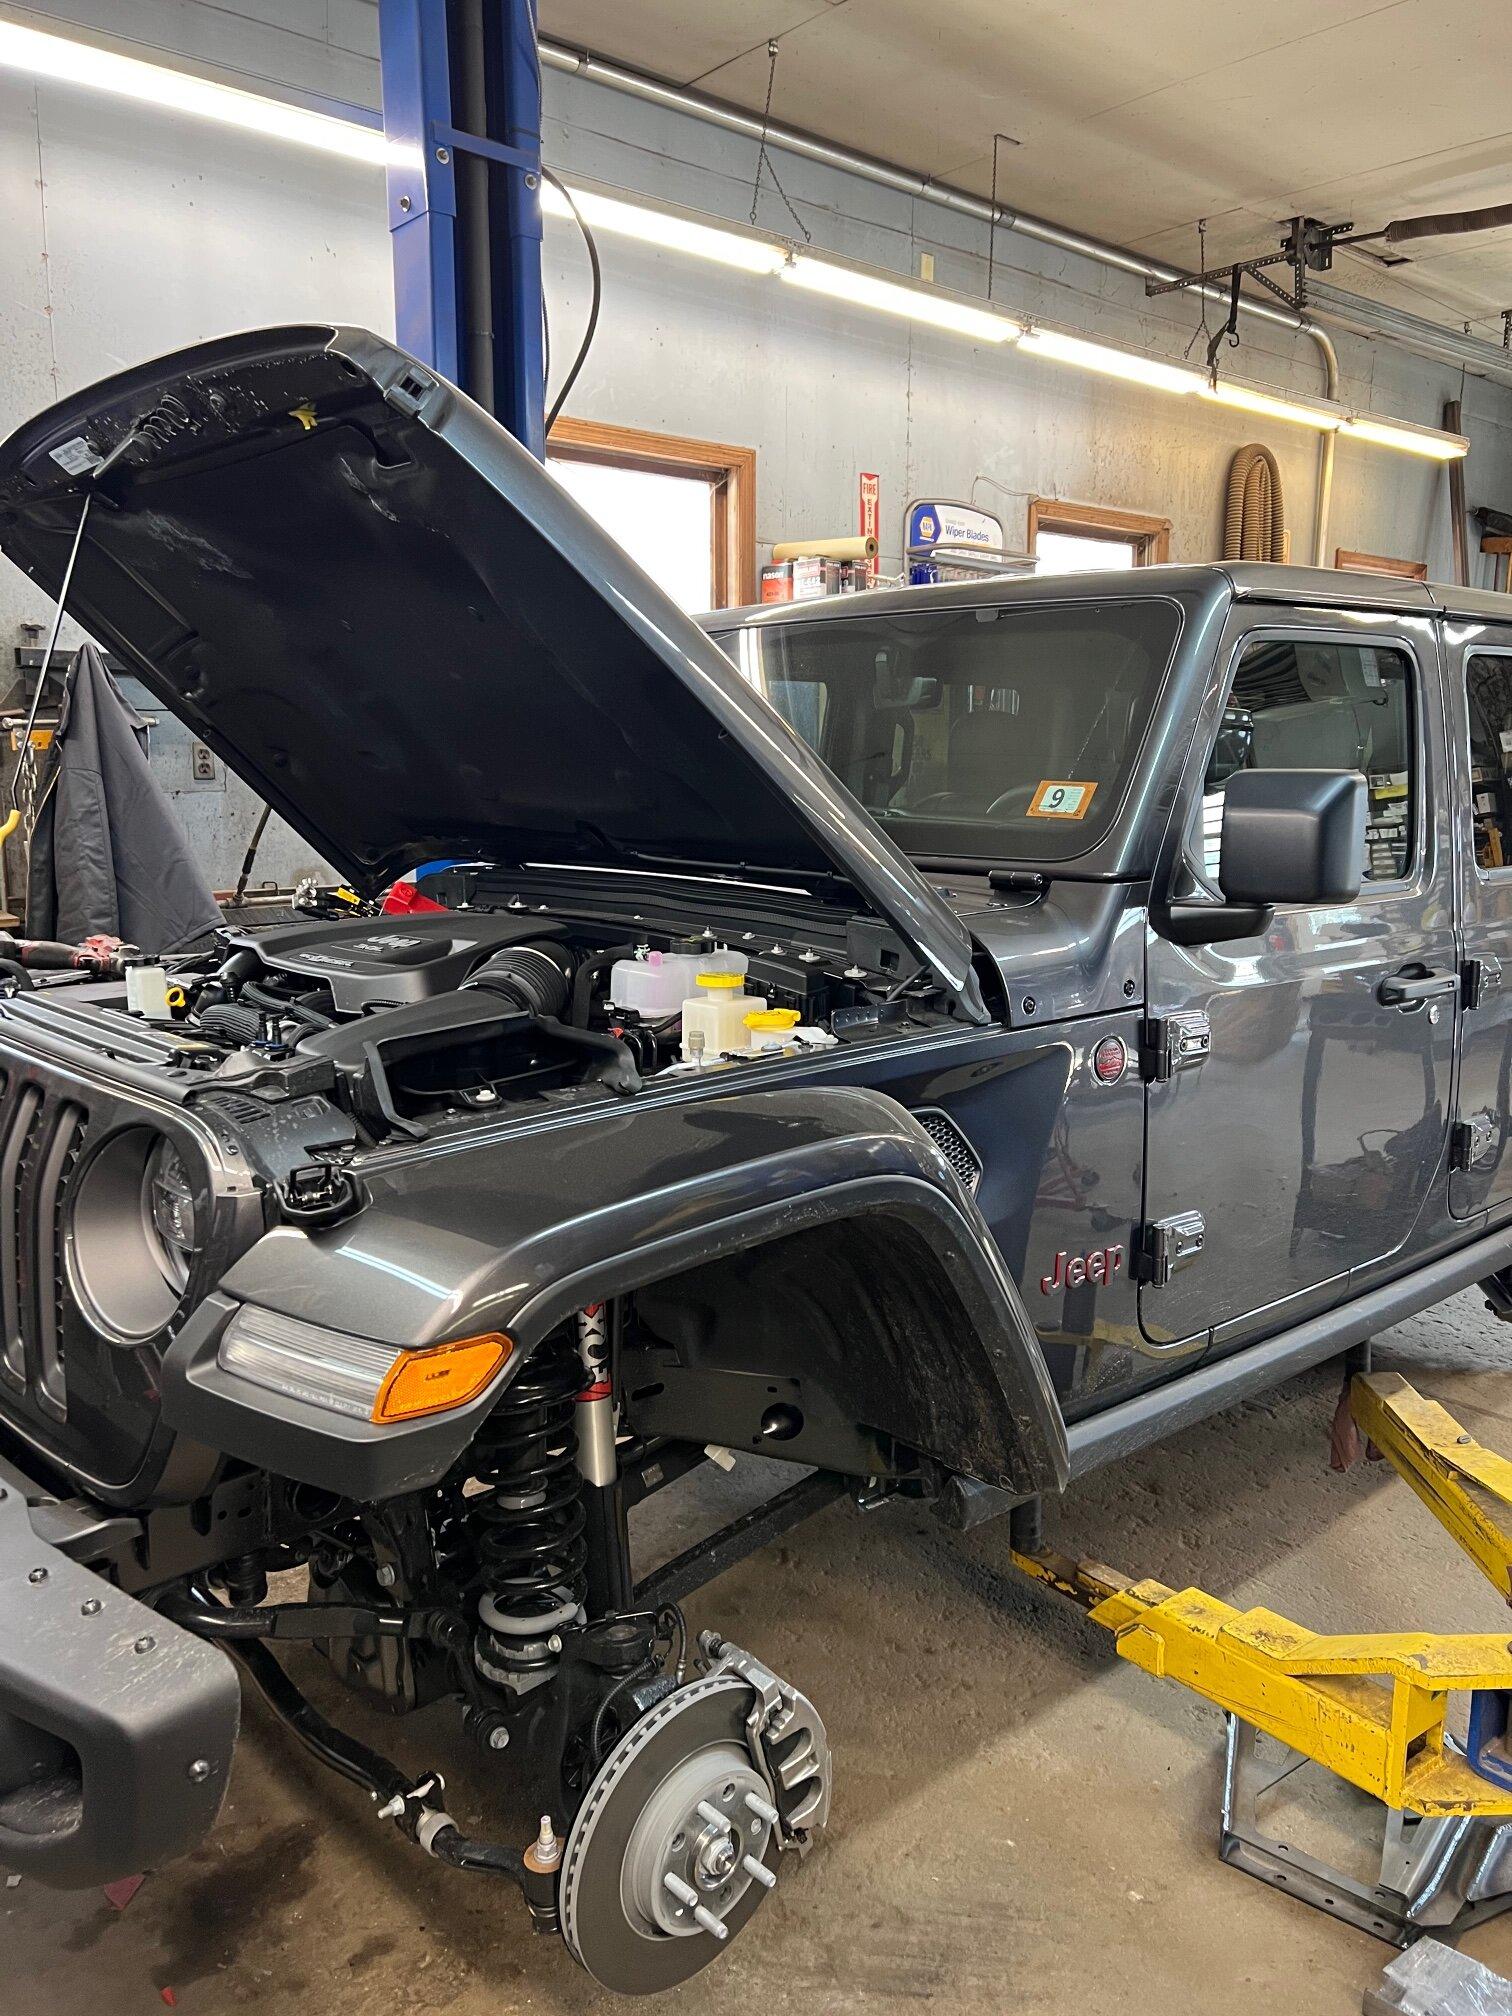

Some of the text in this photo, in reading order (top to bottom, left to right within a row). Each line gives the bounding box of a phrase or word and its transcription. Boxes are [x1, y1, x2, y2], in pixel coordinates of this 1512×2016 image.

[862, 482, 877, 496] FIRE
[945, 524, 990, 543] Wiper Blades
[1049, 788, 1065, 808] 9
[1041, 1244, 1124, 1296] Jeep
